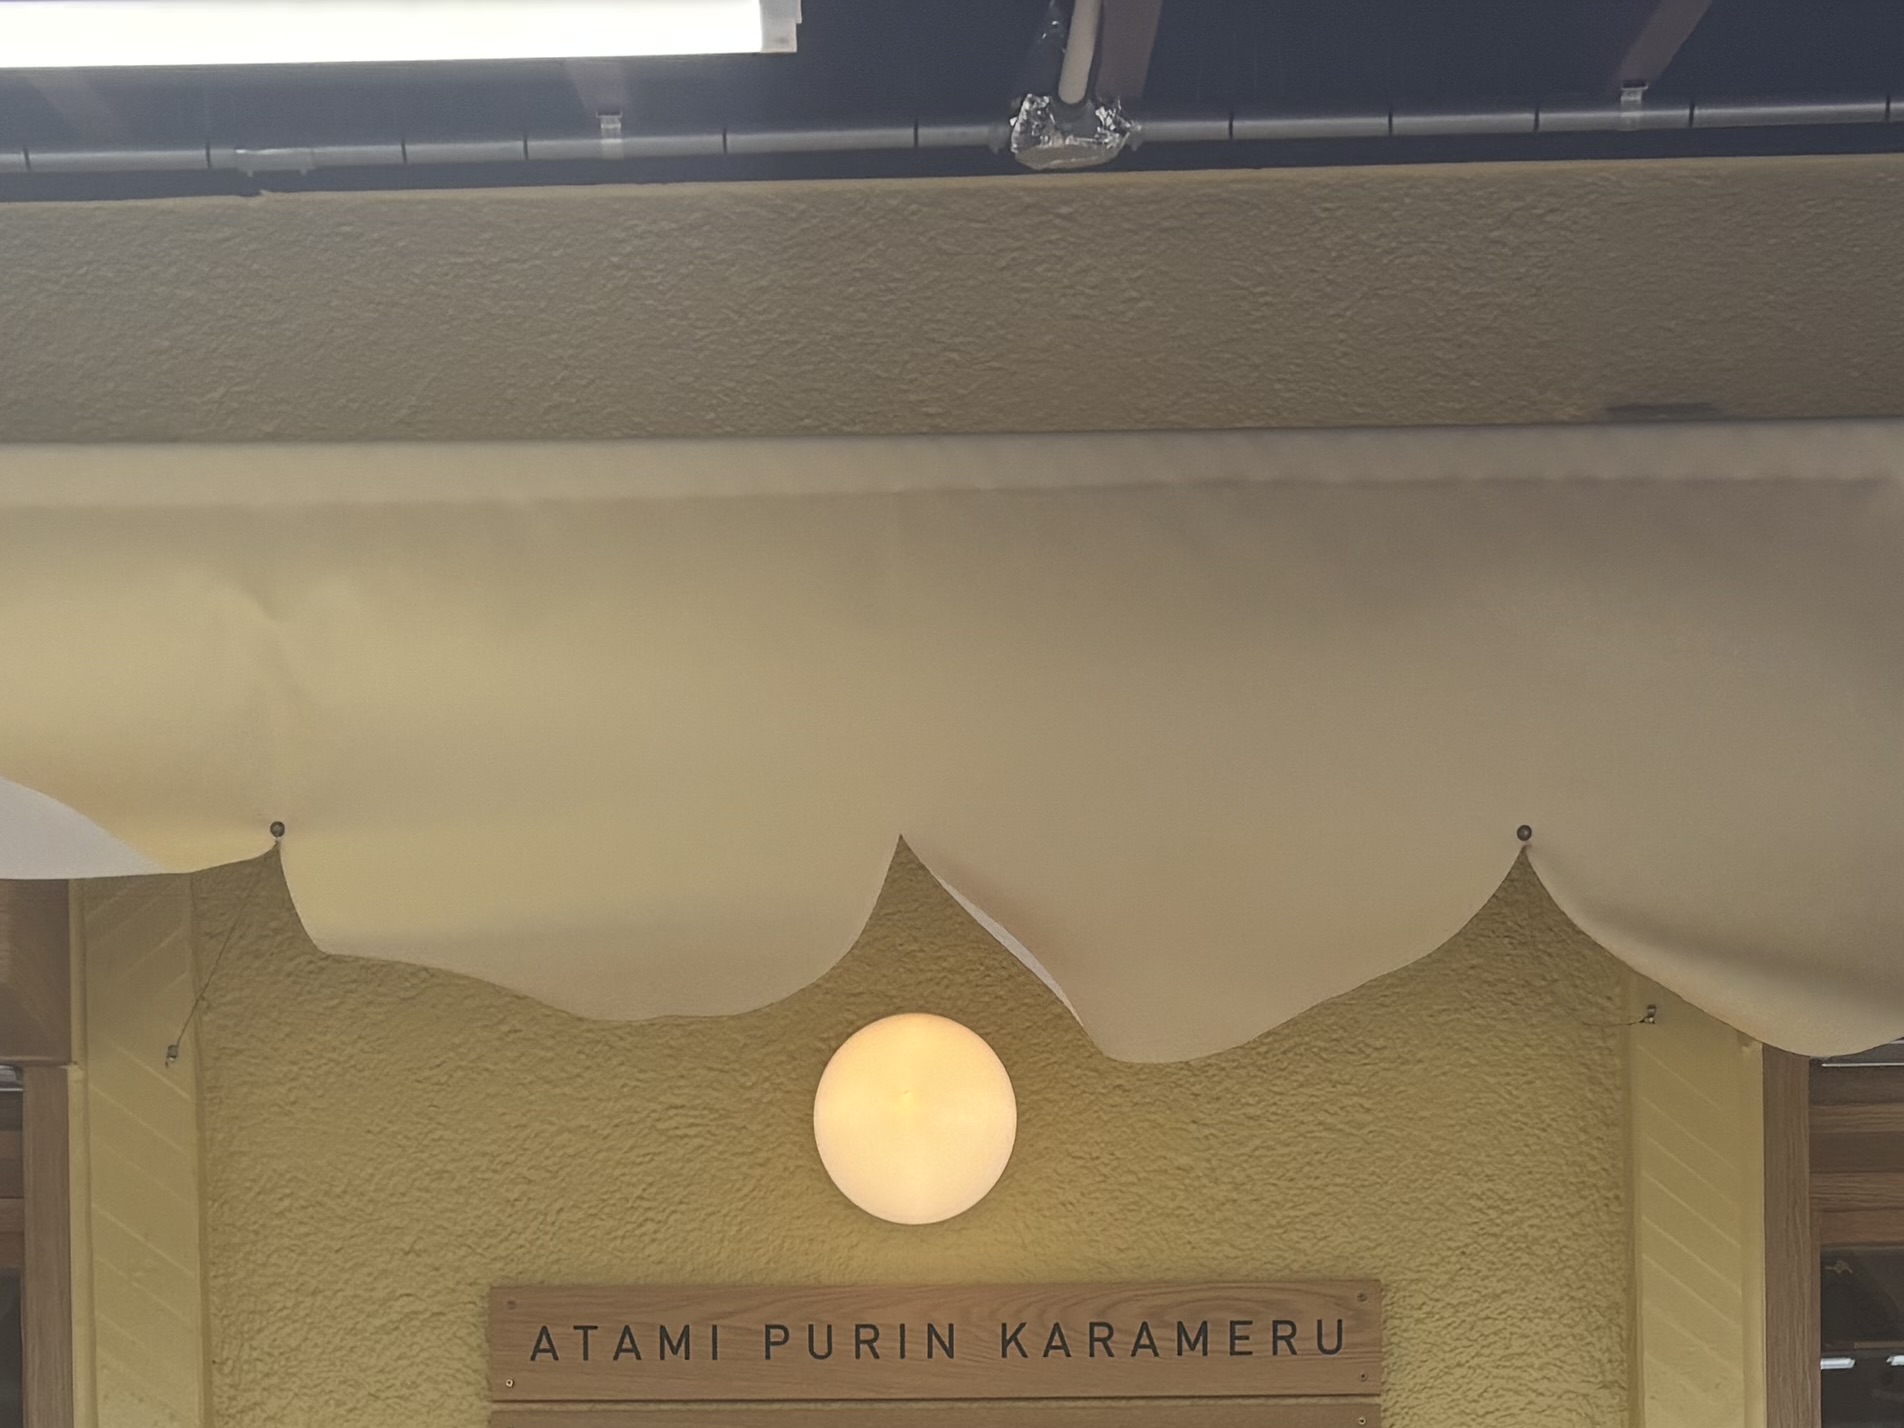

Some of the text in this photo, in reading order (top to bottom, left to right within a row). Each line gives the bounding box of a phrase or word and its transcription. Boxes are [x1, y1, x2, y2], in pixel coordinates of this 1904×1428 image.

[530, 1318, 1346, 1362] ATAMI PURIN KARAMERU
